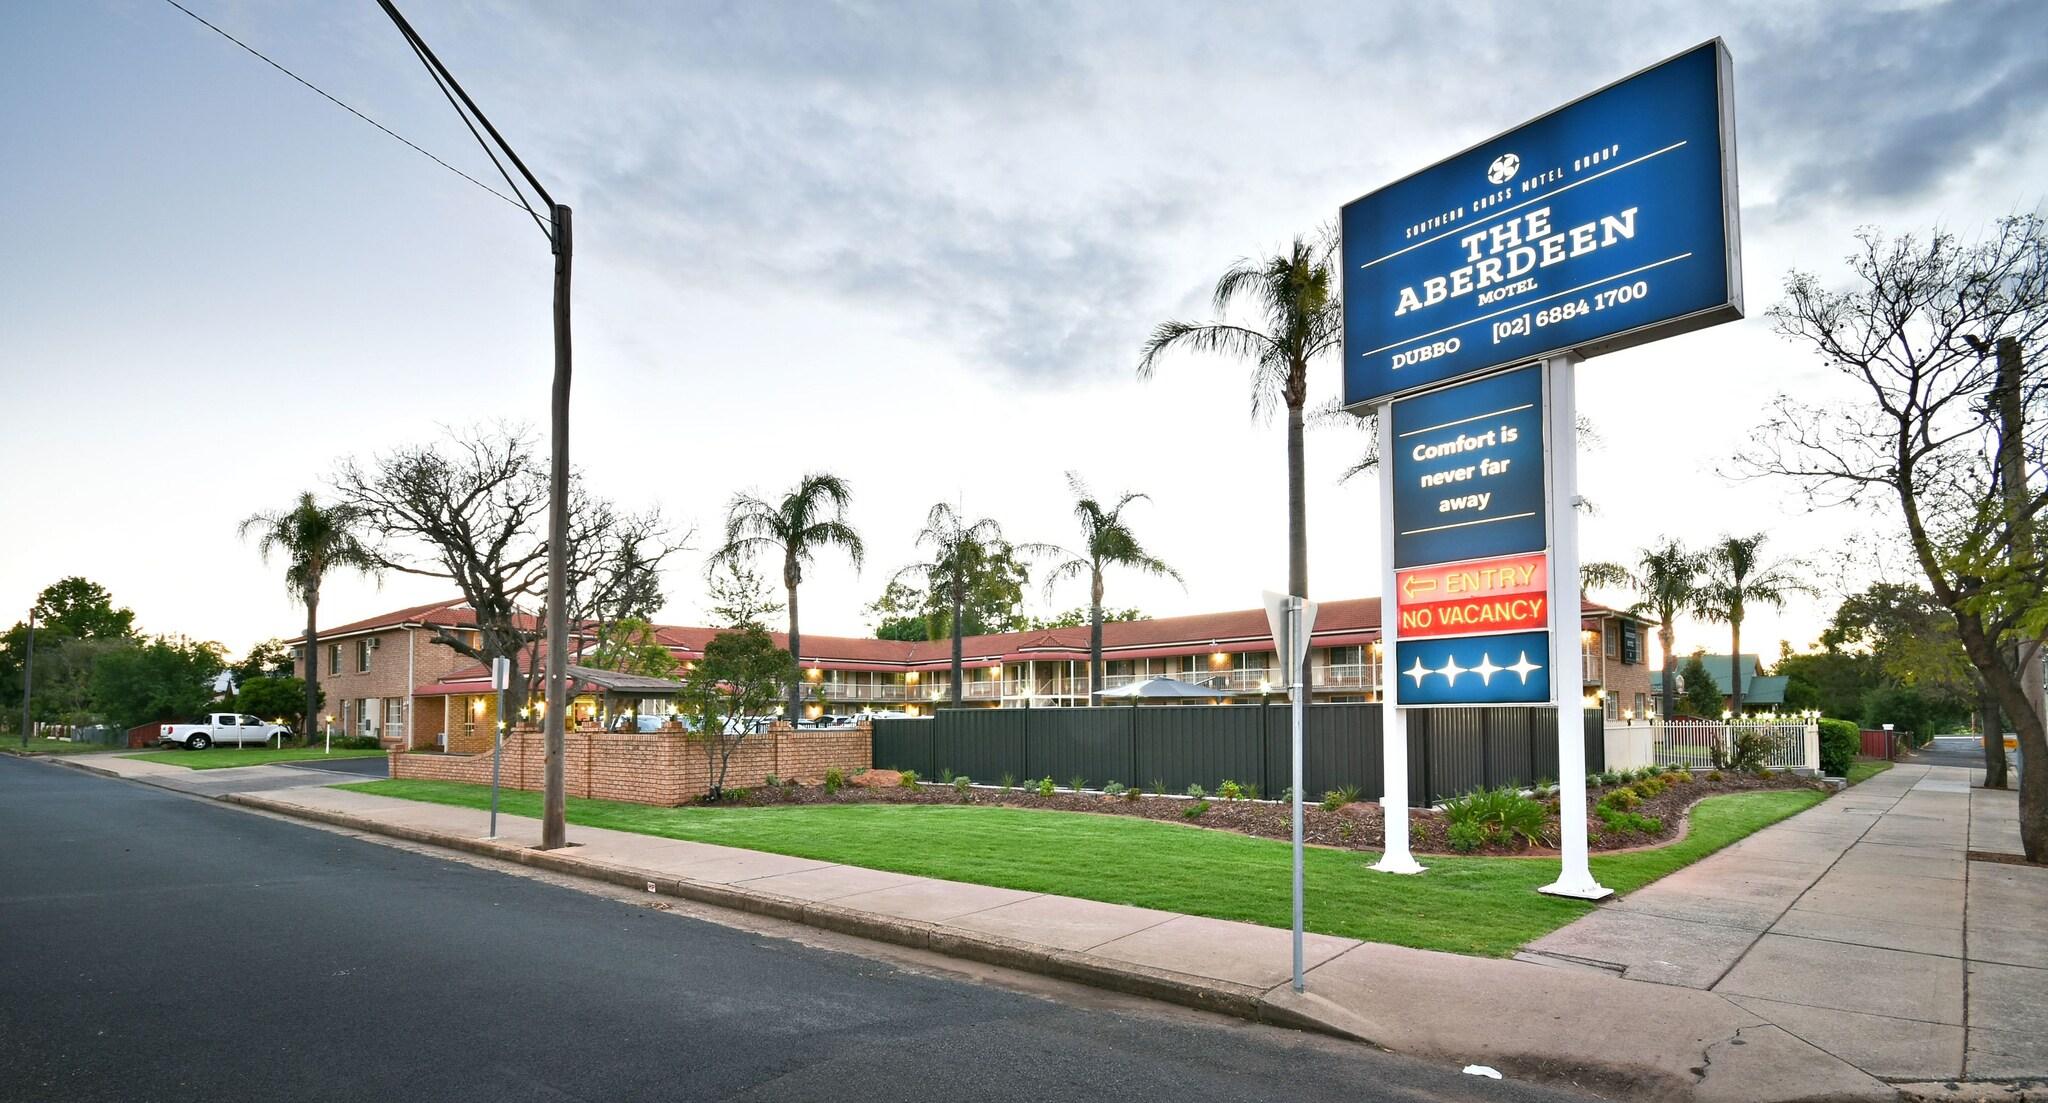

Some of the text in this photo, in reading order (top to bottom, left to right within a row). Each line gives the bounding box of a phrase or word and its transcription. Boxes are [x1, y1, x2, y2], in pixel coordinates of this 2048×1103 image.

[1406, 144, 1619, 238] SOUTHERN CROSS MOTEL GROUP
[1461, 206, 1551, 263] THE
[1394, 207, 1638, 317] ABERDEEN
[1478, 278, 1538, 306] MOTEL
[1391, 281, 1648, 370] DUBBO [02] 6884 1700
[1412, 425, 1518, 461] Comfort is
[1420, 458, 1511, 488] never far
[1438, 492, 1491, 513] away
[1446, 564, 1537, 593] ENTRY
[1403, 599, 1543, 629] NO VACANCY
